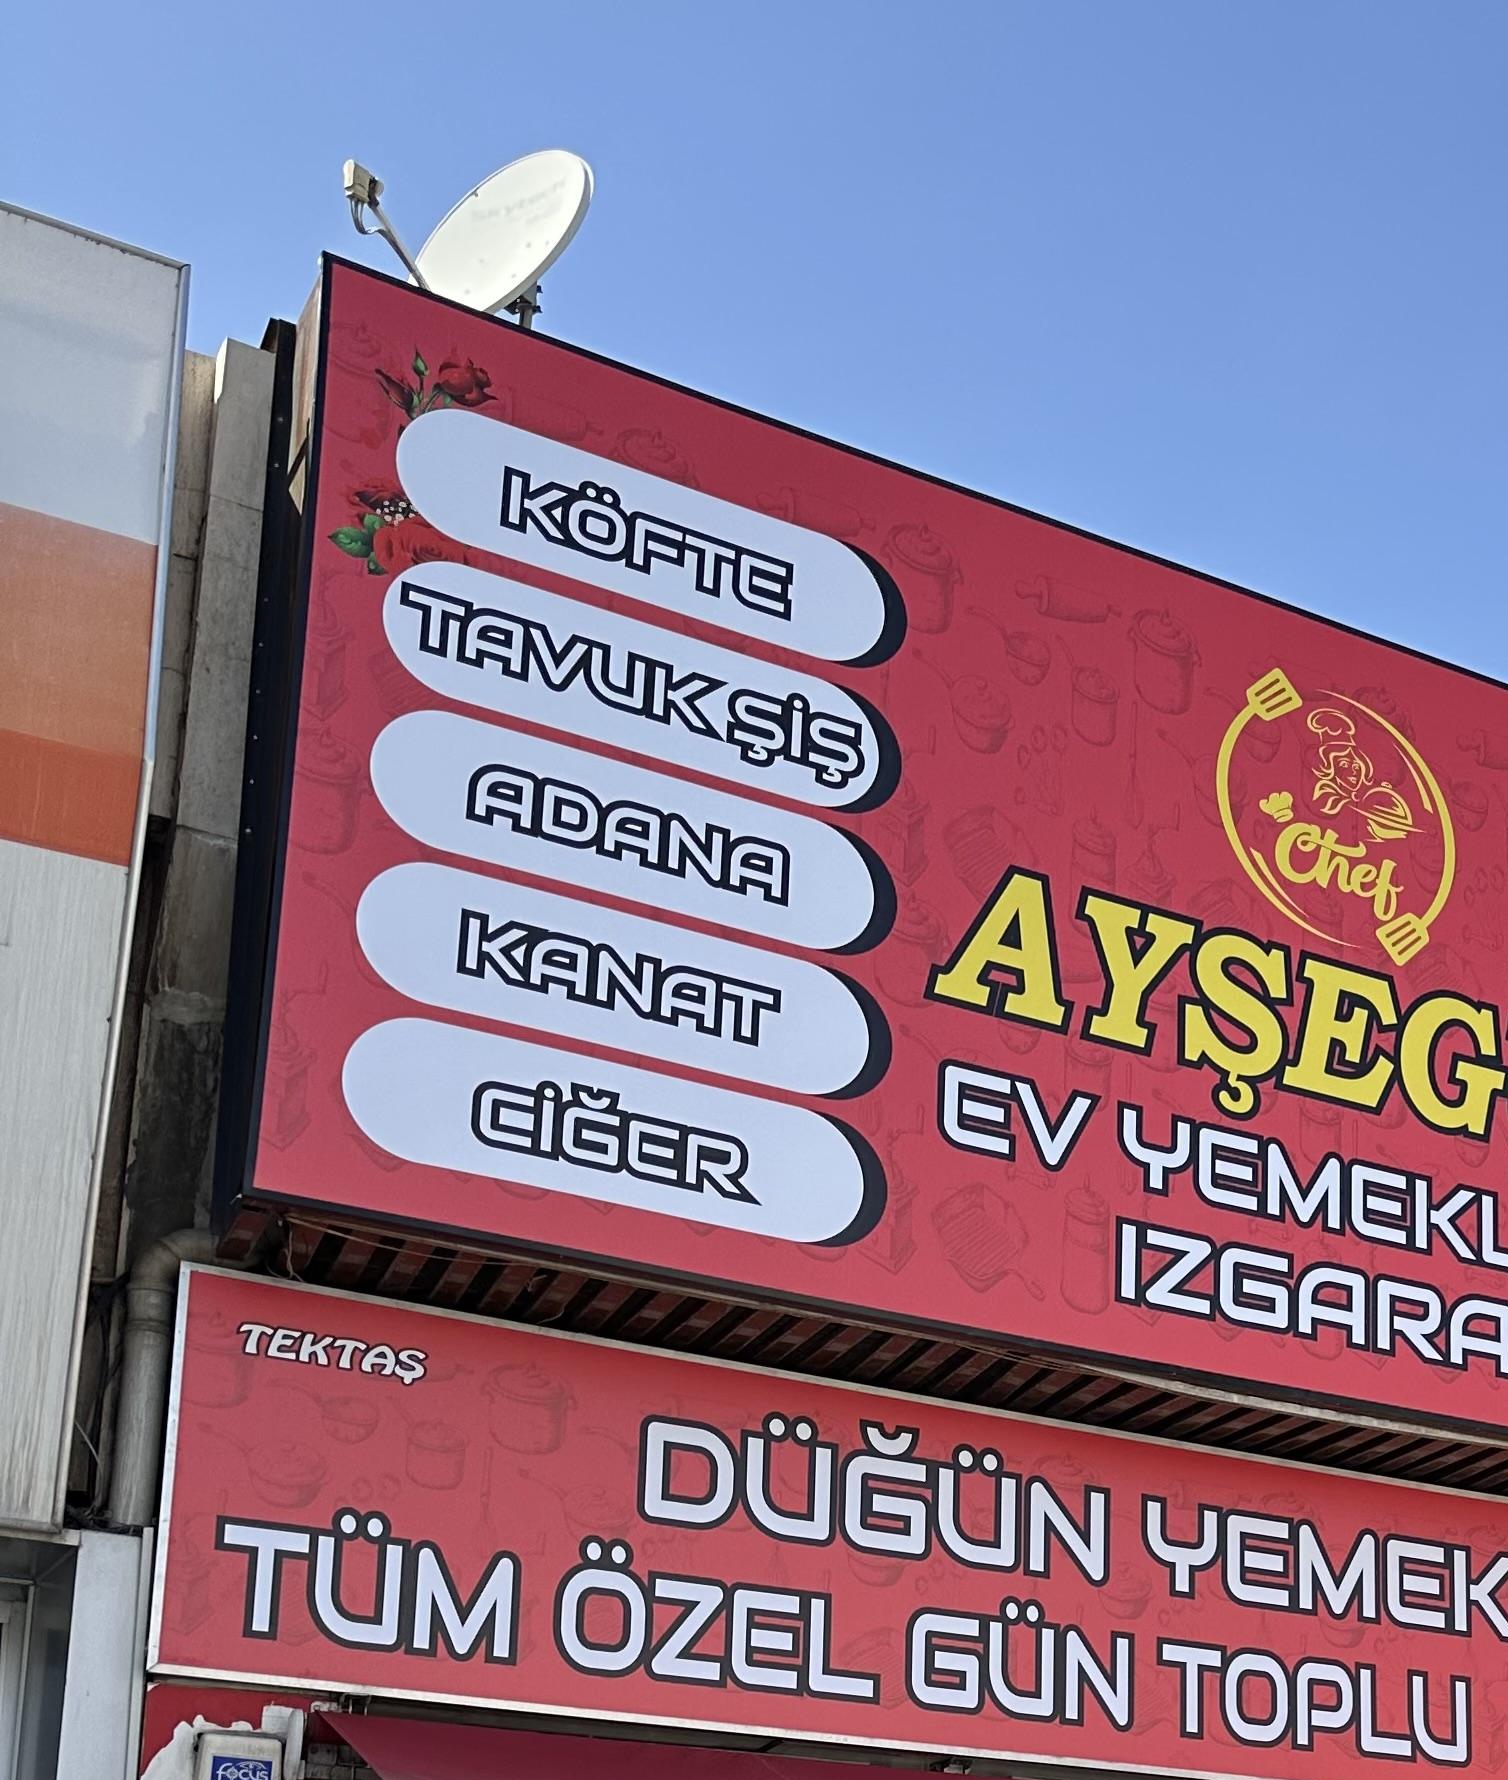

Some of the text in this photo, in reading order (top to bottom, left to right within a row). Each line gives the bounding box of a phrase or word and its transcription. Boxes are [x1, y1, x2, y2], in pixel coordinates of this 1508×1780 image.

[501, 468, 792, 621] KÖFTE
[400, 581, 866, 789] TAVUK ŞİŞ
[466, 763, 791, 906] ADANA
[1274, 822, 1404, 920] Chef
[457, 909, 782, 1046] KANAT
[471, 1081, 762, 1206] CİĞER
[938, 1059, 1099, 1171] EV
[237, 1321, 427, 1385] TEKTAŞ
[639, 1412, 1109, 1587] DÜĞÜN
[215, 1507, 522, 1665] TÜM
[554, 1535, 881, 1704] ÖZEL
[906, 1597, 1135, 1732] GÜN
[1156, 1635, 1471, 1767] TOPLU
